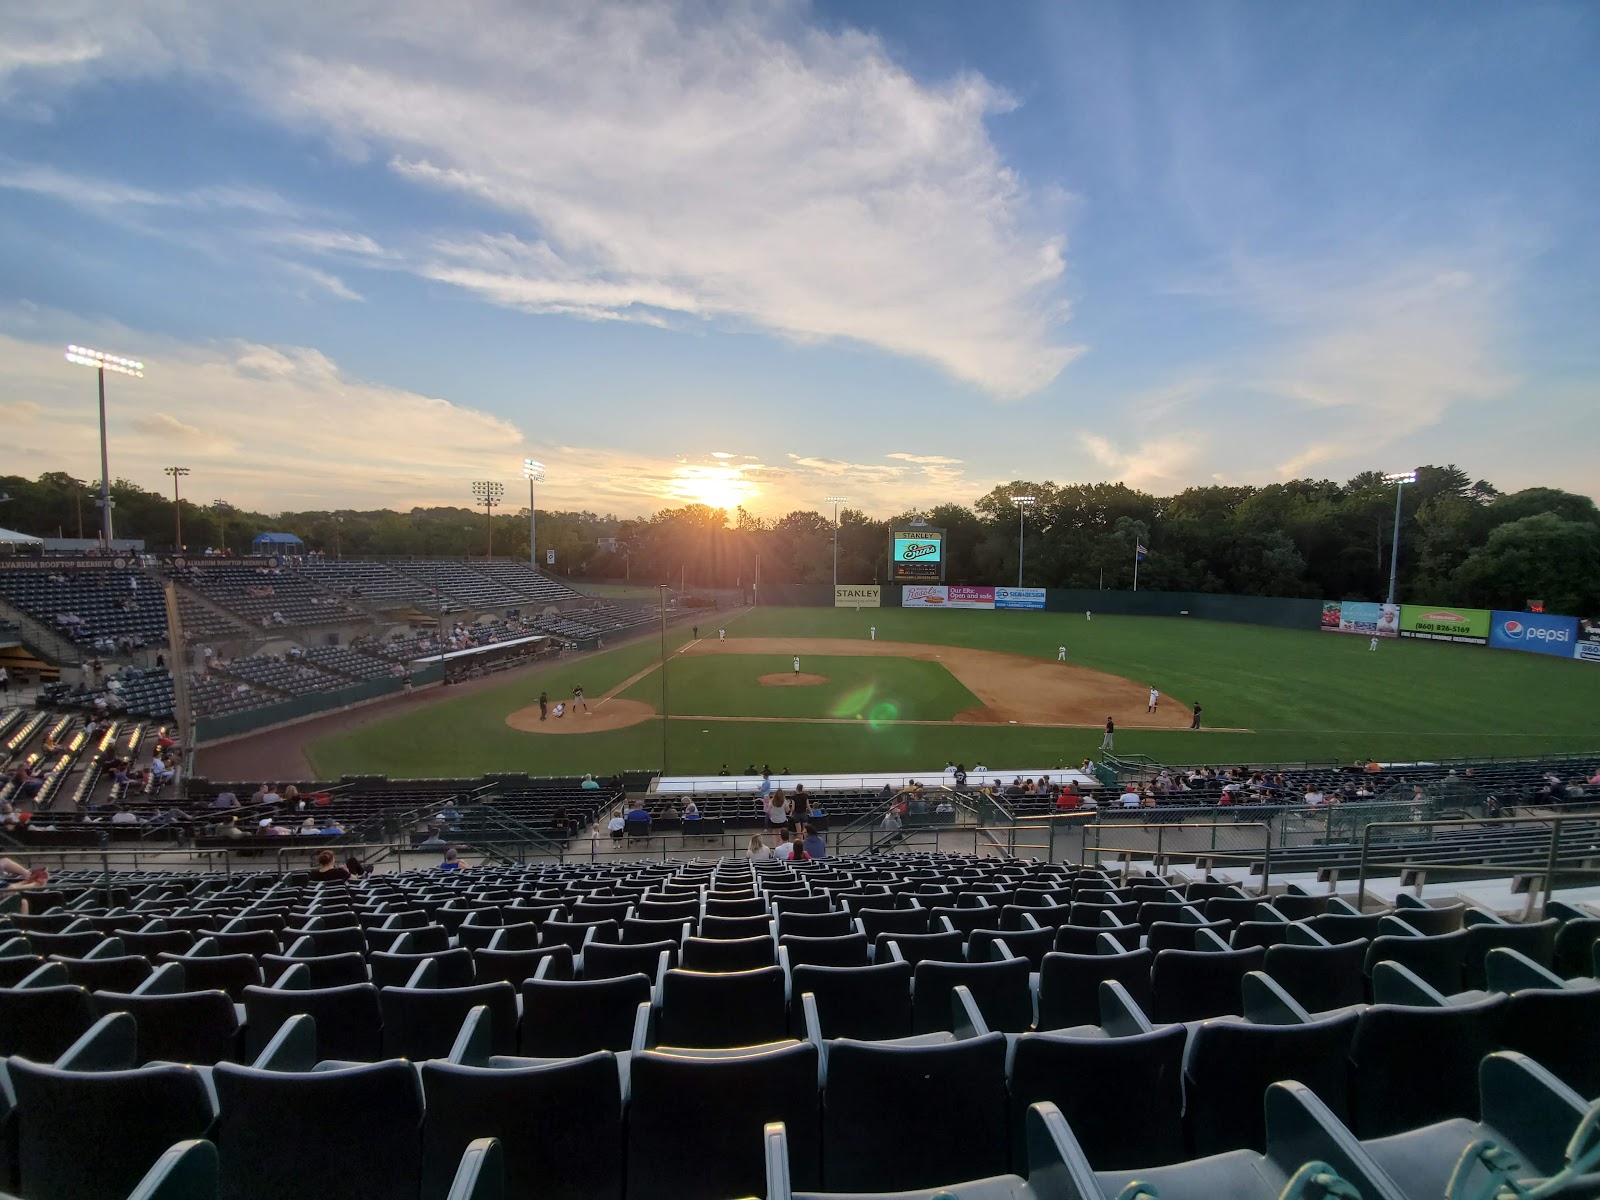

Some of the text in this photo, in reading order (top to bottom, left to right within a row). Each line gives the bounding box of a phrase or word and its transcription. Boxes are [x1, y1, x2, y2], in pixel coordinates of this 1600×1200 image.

[903, 544, 936, 560] Suns
[836, 589, 879, 598] STANLEY
[1415, 623, 1471, 634] (860) 826-5169
[1526, 627, 1569, 643] pepsi
